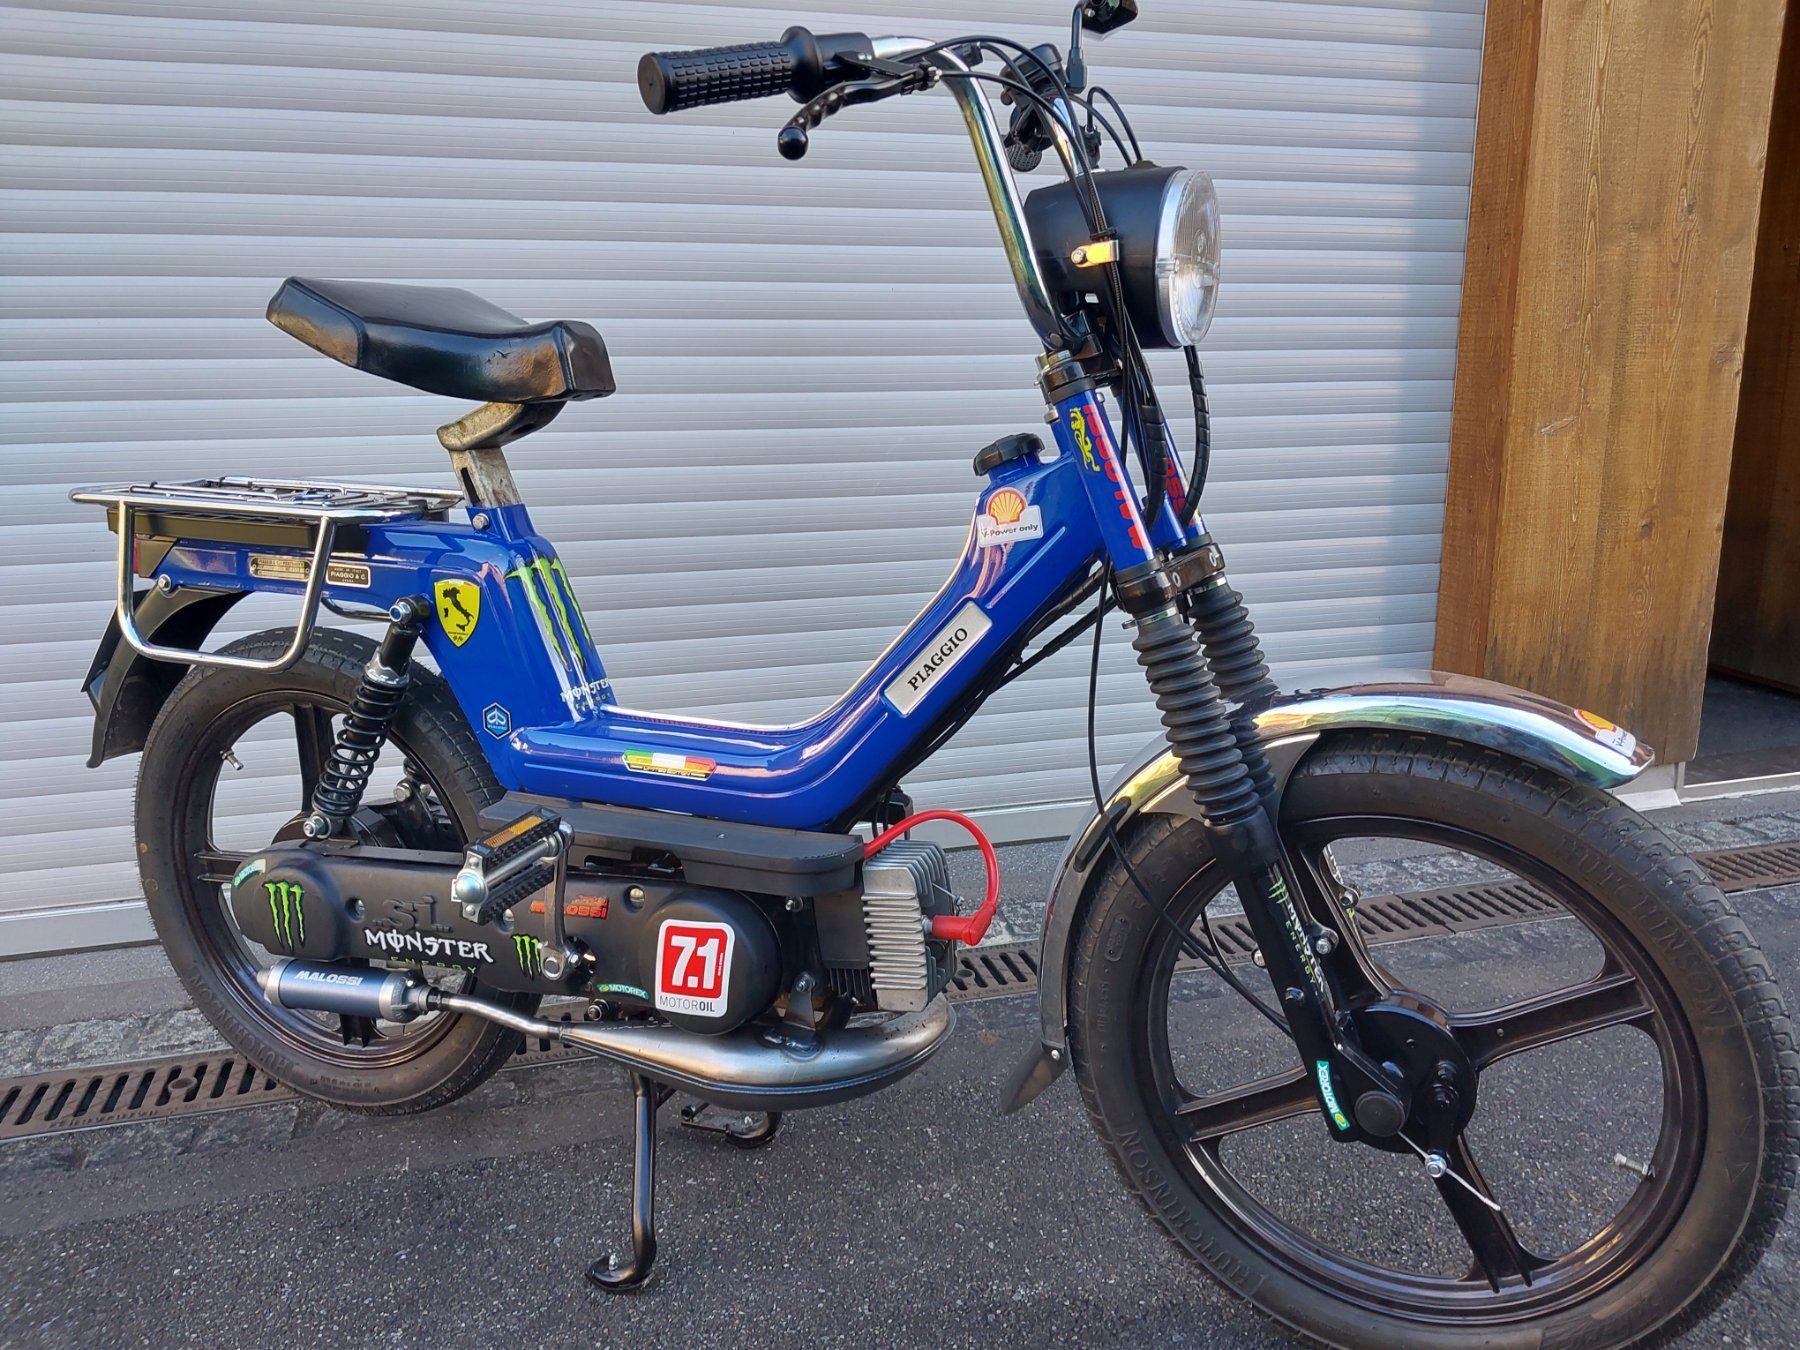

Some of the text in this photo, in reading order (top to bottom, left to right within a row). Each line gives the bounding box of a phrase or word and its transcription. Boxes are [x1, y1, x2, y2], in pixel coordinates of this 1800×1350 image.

[1019, 523, 1039, 533] only
[907, 627, 968, 691] PIAGGIO
[530, 901, 609, 919] MOSSI
[364, 929, 494, 964] MONSTER
[671, 935, 720, 990] 7.1
[294, 970, 363, 987] MALOSSI
[608, 983, 648, 999] MOTOREX
[1318, 1063, 1340, 1113] MOTOREX
